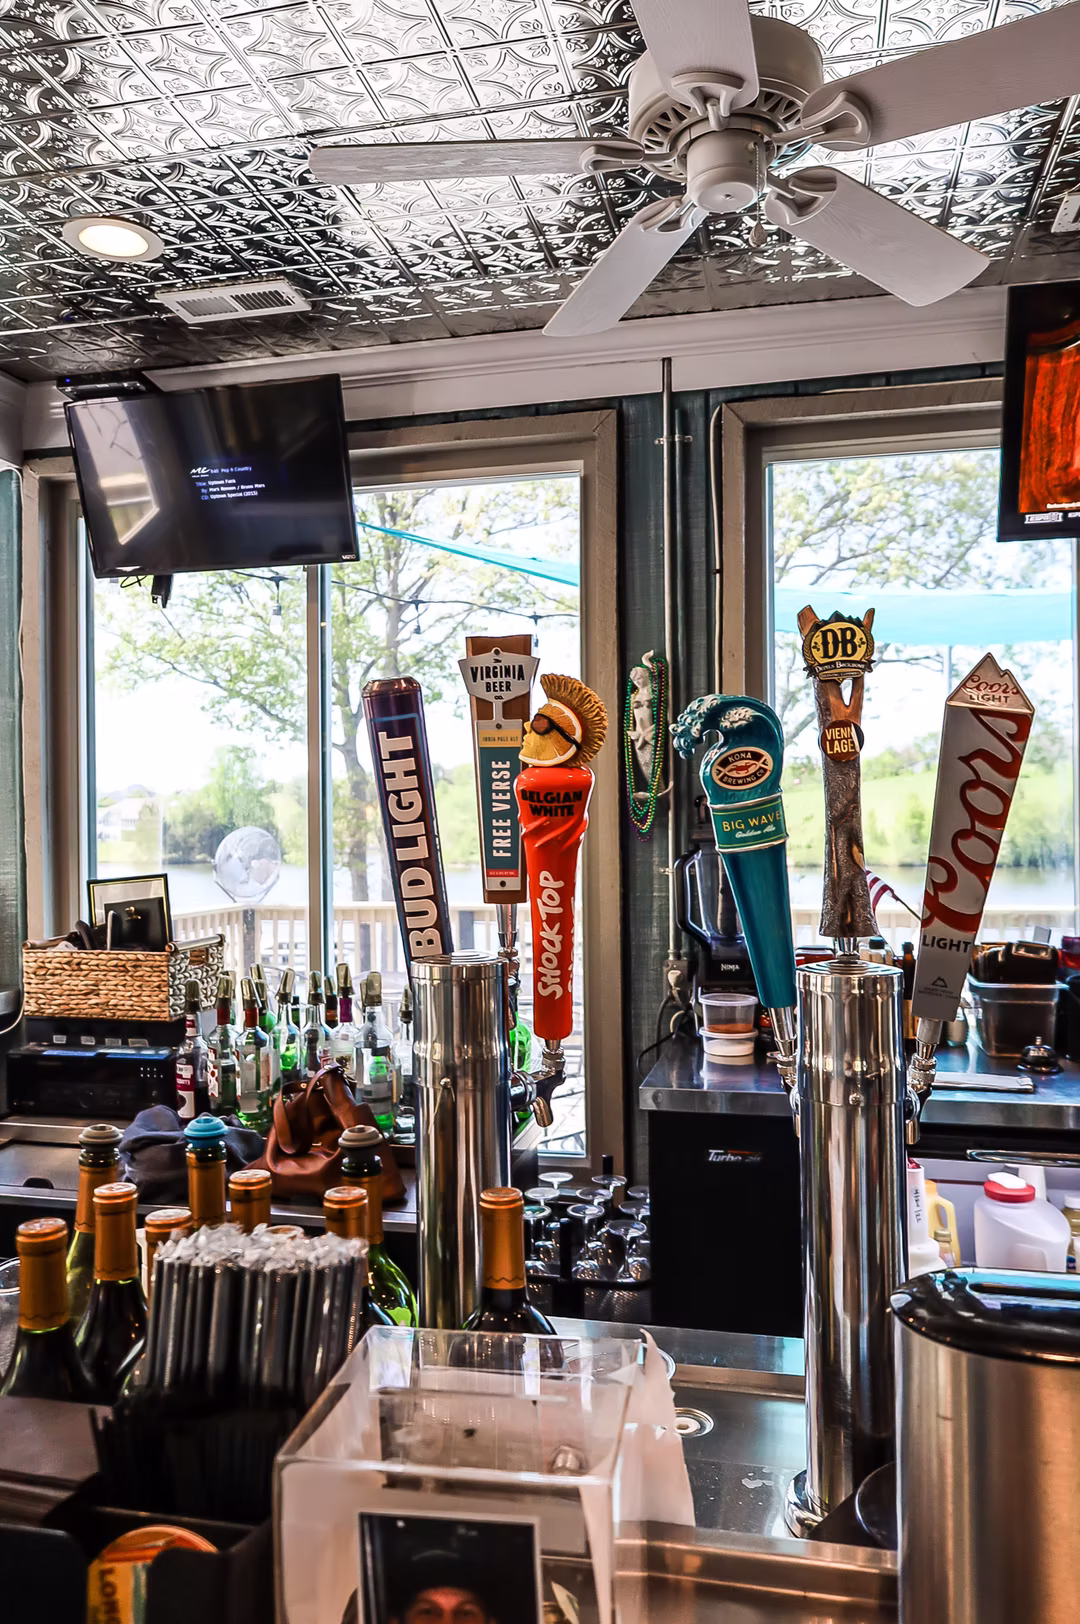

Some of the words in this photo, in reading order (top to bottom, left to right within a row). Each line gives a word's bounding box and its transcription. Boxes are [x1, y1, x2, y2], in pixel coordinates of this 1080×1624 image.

[820, 626, 858, 659] DB
[470, 664, 526, 683] VIRGINIA
[485, 680, 512, 693] BEER
[961, 674, 1021, 695] Coors
[968, 694, 1010, 703] LIGHT
[824, 727, 853, 740] VIENN
[826, 739, 856, 755] LAGE
[727, 752, 752, 763] KONA
[491, 760, 511, 812] VERSE
[722, 774, 757, 785] BREWING
[378, 731, 429, 861] LIGHT
[521, 789, 583, 804] BELGIAN
[529, 803, 575, 817] WHITE
[722, 819, 745, 832] BIG
[747, 810, 782, 827] WAVE
[921, 708, 1032, 934] Coors
[492, 819, 512, 857] FREE
[400, 866, 443, 958] BUD
[921, 934, 972, 954] LIGHT
